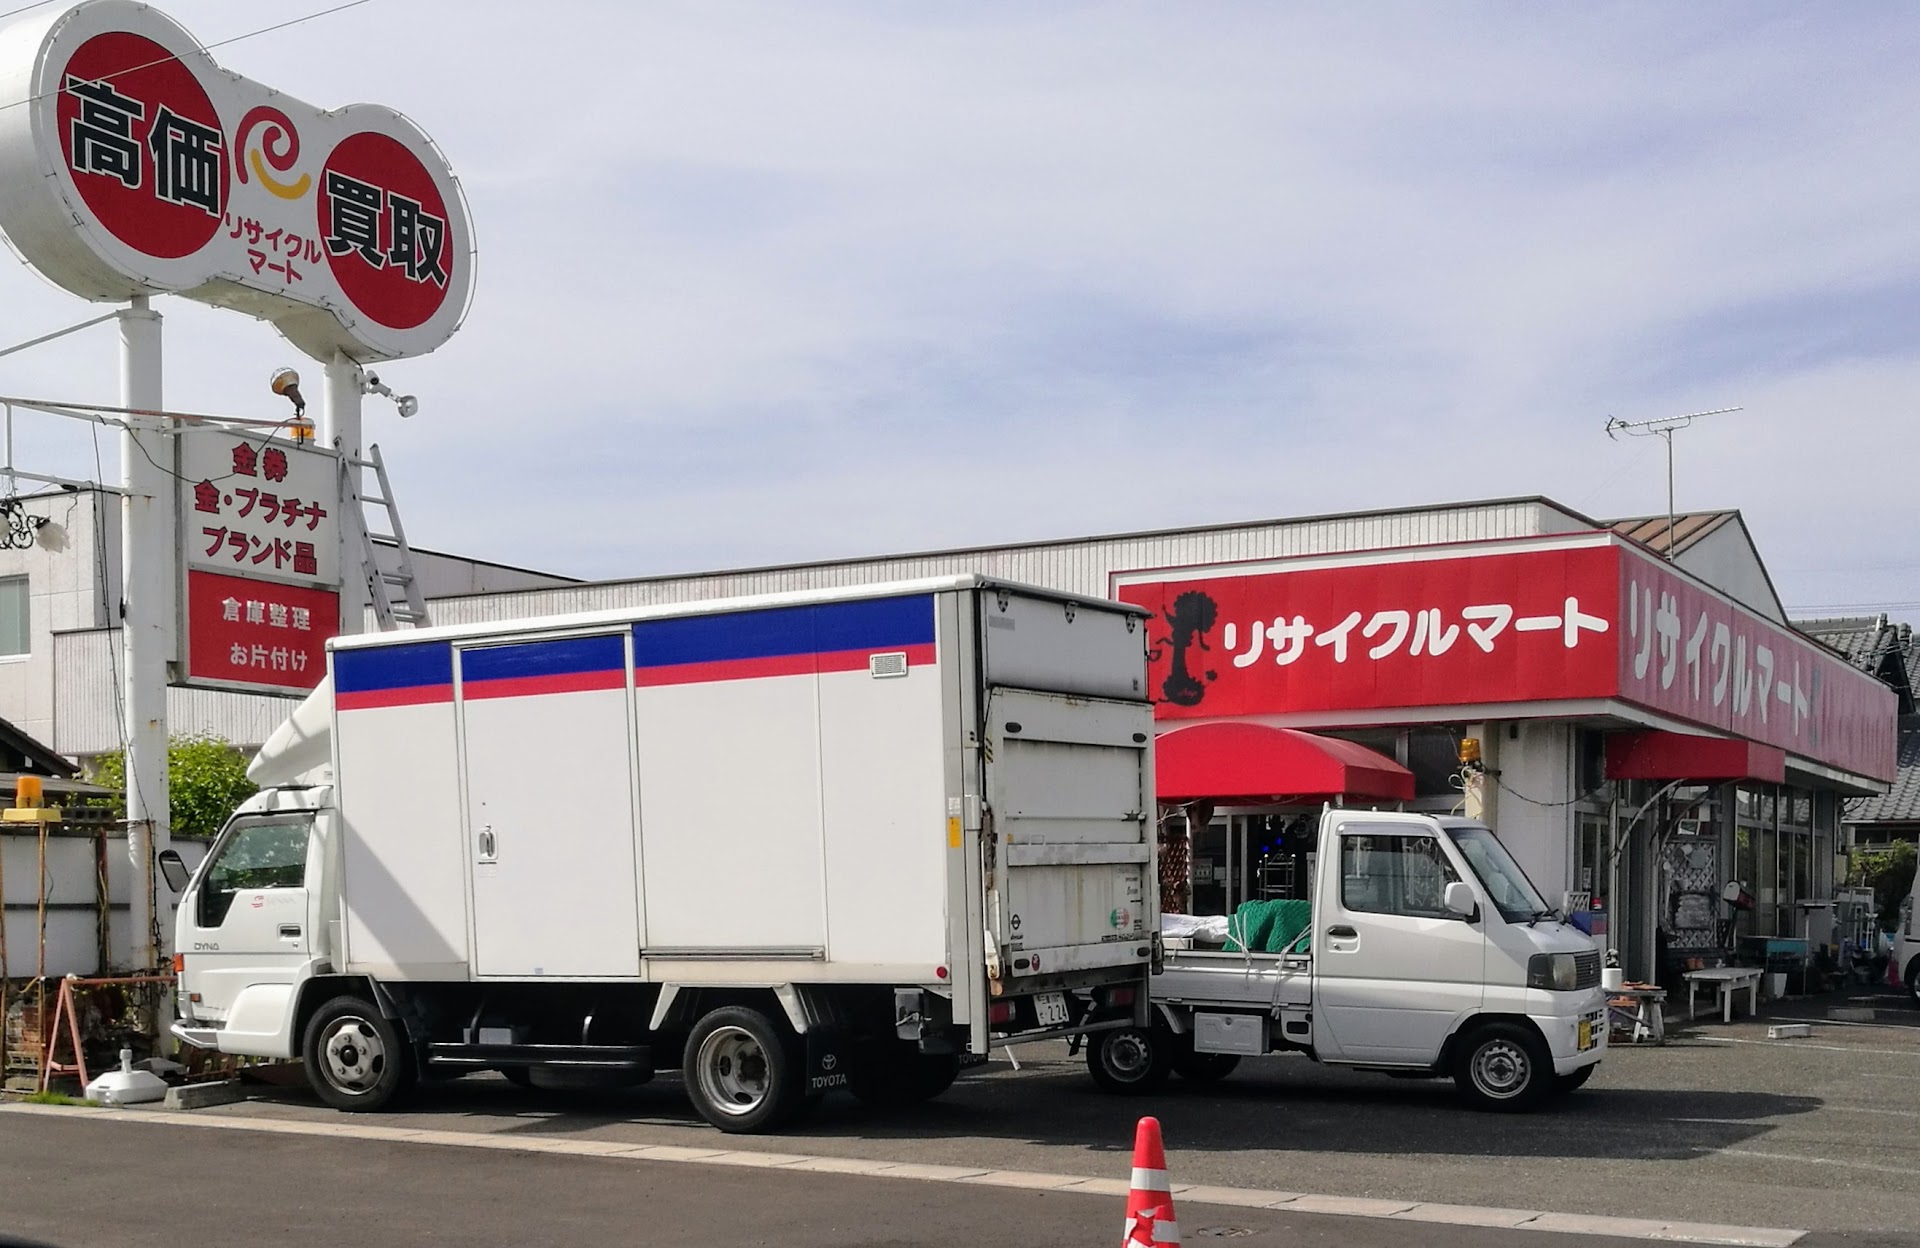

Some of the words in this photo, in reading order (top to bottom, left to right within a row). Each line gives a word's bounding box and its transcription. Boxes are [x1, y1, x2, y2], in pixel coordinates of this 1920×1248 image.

[66, 73, 223, 218] 高価
[324, 169, 446, 289] 買取
[226, 212, 321, 263] リサイクル
[247, 249, 303, 284] マート
[231, 441, 289, 482] 金券
[194, 478, 327, 531] 金・プラチナ
[202, 526, 317, 575] ブランド品
[222, 597, 312, 631] 倉庫整理
[1224, 596, 1609, 668] リサイクルマート
[230, 642, 308, 672] お片付け
[1630, 579, 1809, 737] リサイクルマート
[193, 942, 220, 951] DYNA
[811, 1073, 847, 1089] TOYOTA
